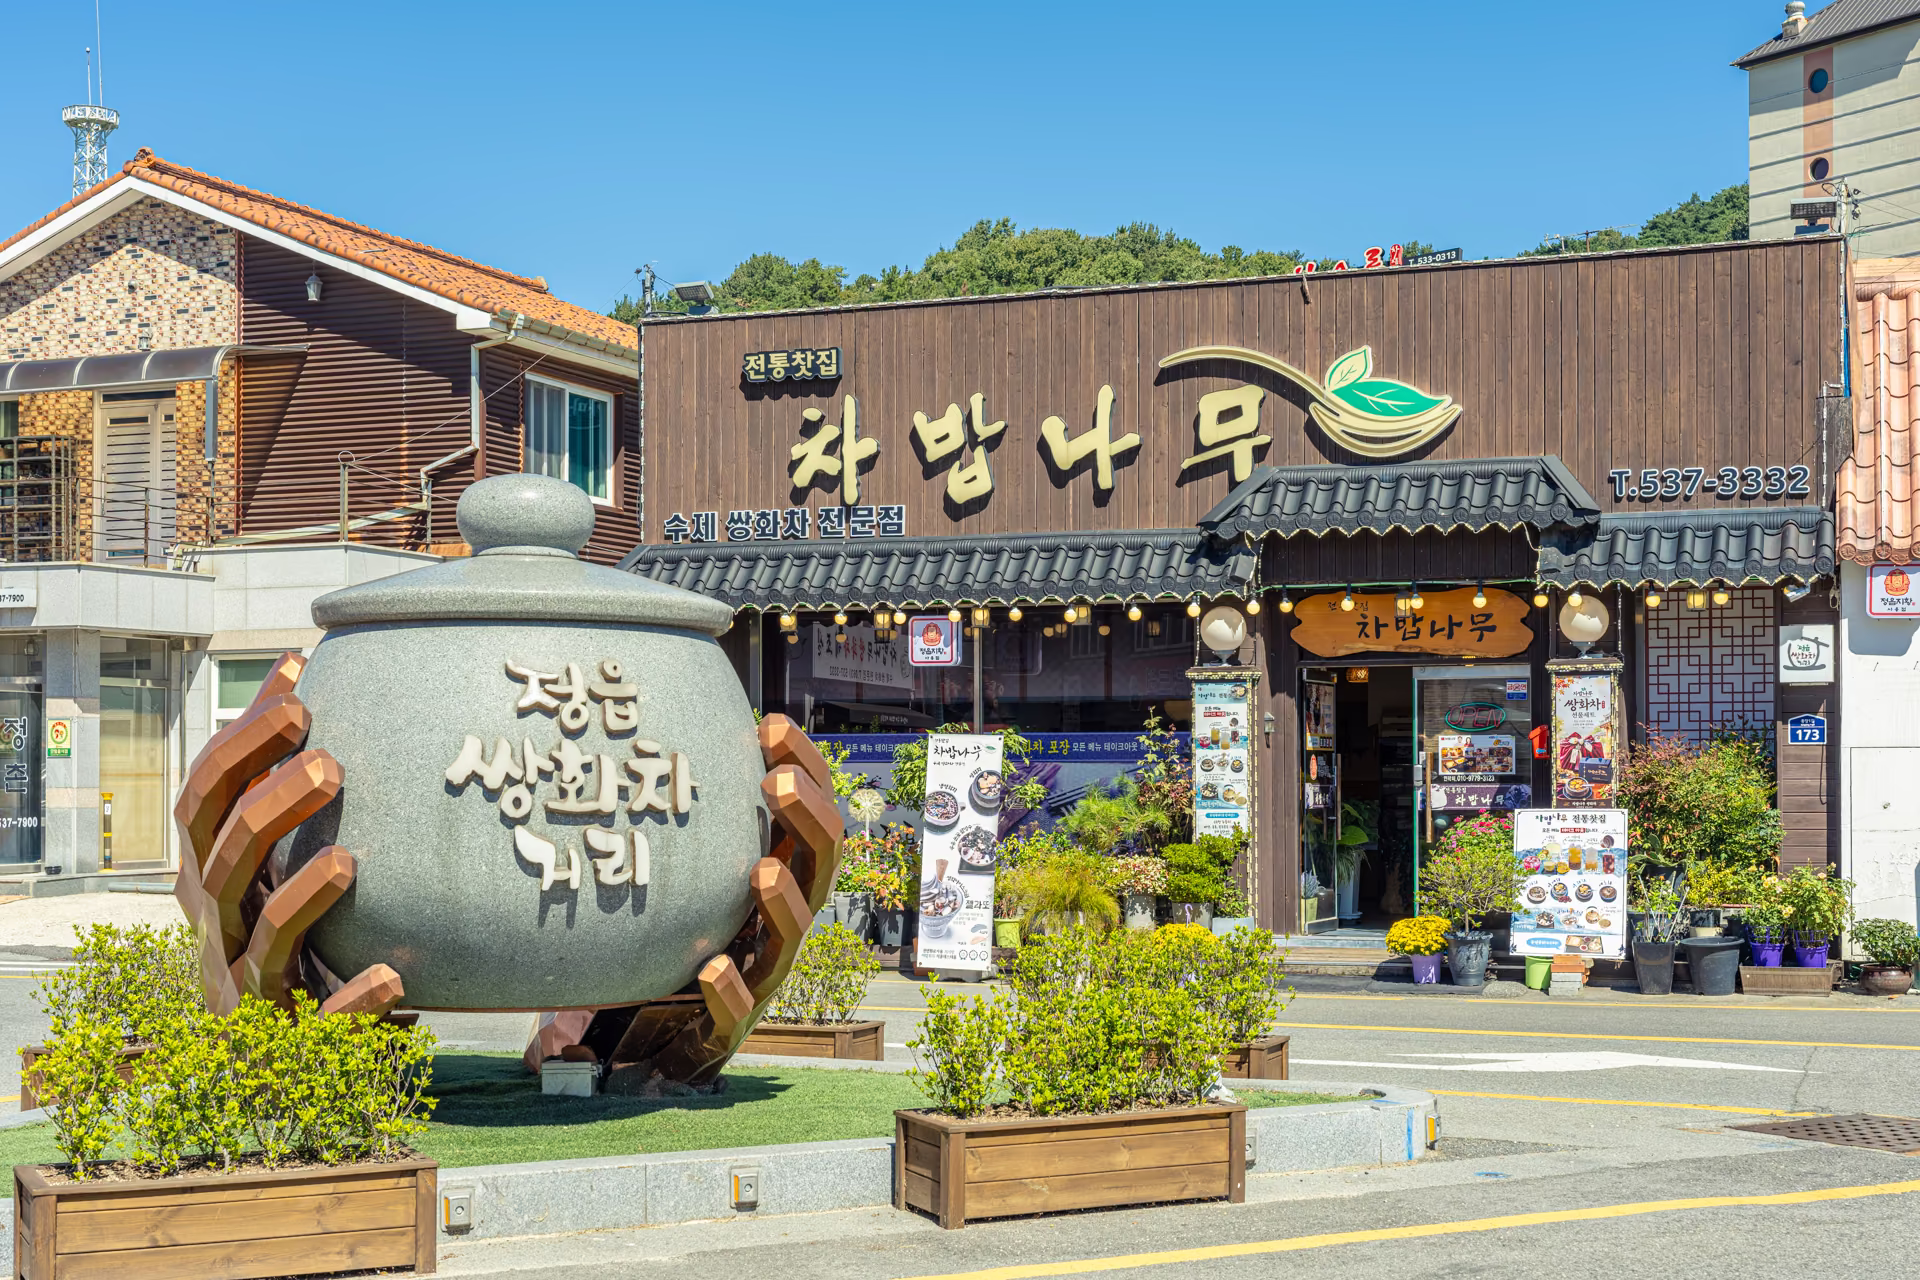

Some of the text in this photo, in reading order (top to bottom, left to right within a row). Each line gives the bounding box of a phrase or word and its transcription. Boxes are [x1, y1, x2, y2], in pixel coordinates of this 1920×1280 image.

[1417, 250, 1456, 265] 533-0313
[744, 348, 838, 380] 전통찻집
[791, 384, 1274, 506] 차밥나무
[1609, 465, 1811, 498] T.537-3332
[664, 504, 906, 544] 수제 쌍화차 전문점
[1880, 597, 1912, 606] 정읍지황
[1355, 612, 1498, 643] 차밥나무
[505, 659, 639, 735] 정읍
[1563, 697, 1602, 712] 쌍화차
[1448, 705, 1504, 728] OPEN
[1796, 729, 1820, 741] 173
[933, 745, 983, 762] 차밥나무
[1047, 739, 1071, 756] 포장
[1072, 742, 1086, 752] 모든
[1088, 742, 1102, 752] 메뉴
[1103, 741, 1138, 752] 테이크아웃
[445, 735, 702, 820] 쌍화차
[1455, 794, 1505, 806] 차밥나무
[1572, 813, 1607, 824] 전통찻집
[514, 824, 651, 891] 거리
[965, 899, 991, 910] 젤라또
